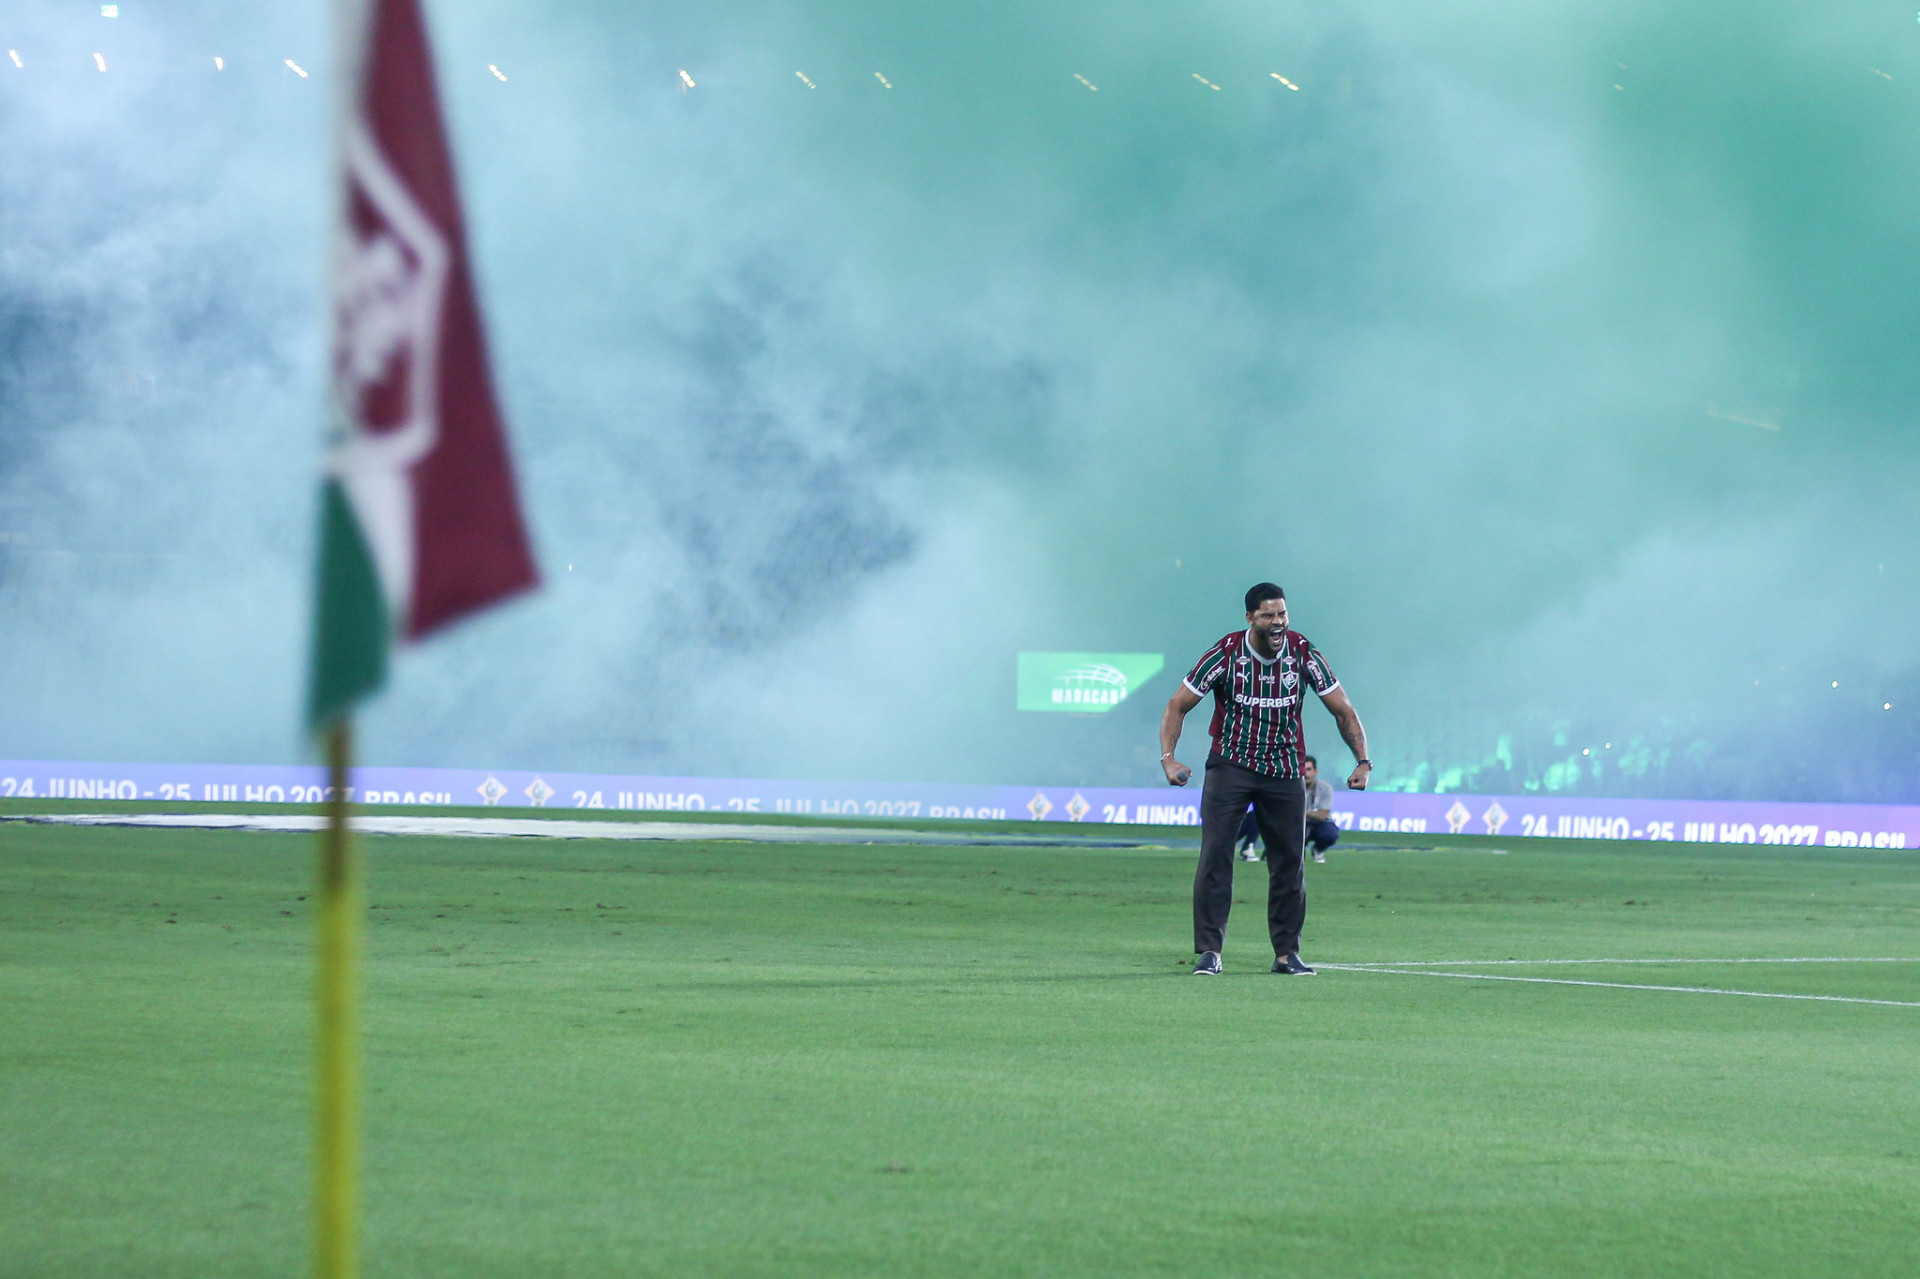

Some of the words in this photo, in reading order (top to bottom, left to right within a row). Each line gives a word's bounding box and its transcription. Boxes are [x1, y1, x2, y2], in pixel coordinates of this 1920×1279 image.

[1235, 694, 1296, 707] SUPERBET
[2, 777, 35, 797] 24
[159, 783, 191, 800] 25
[572, 790, 604, 809] 24
[1103, 804, 1127, 823] 24
[1521, 814, 1548, 837] 24
[1647, 822, 1674, 841] 25
